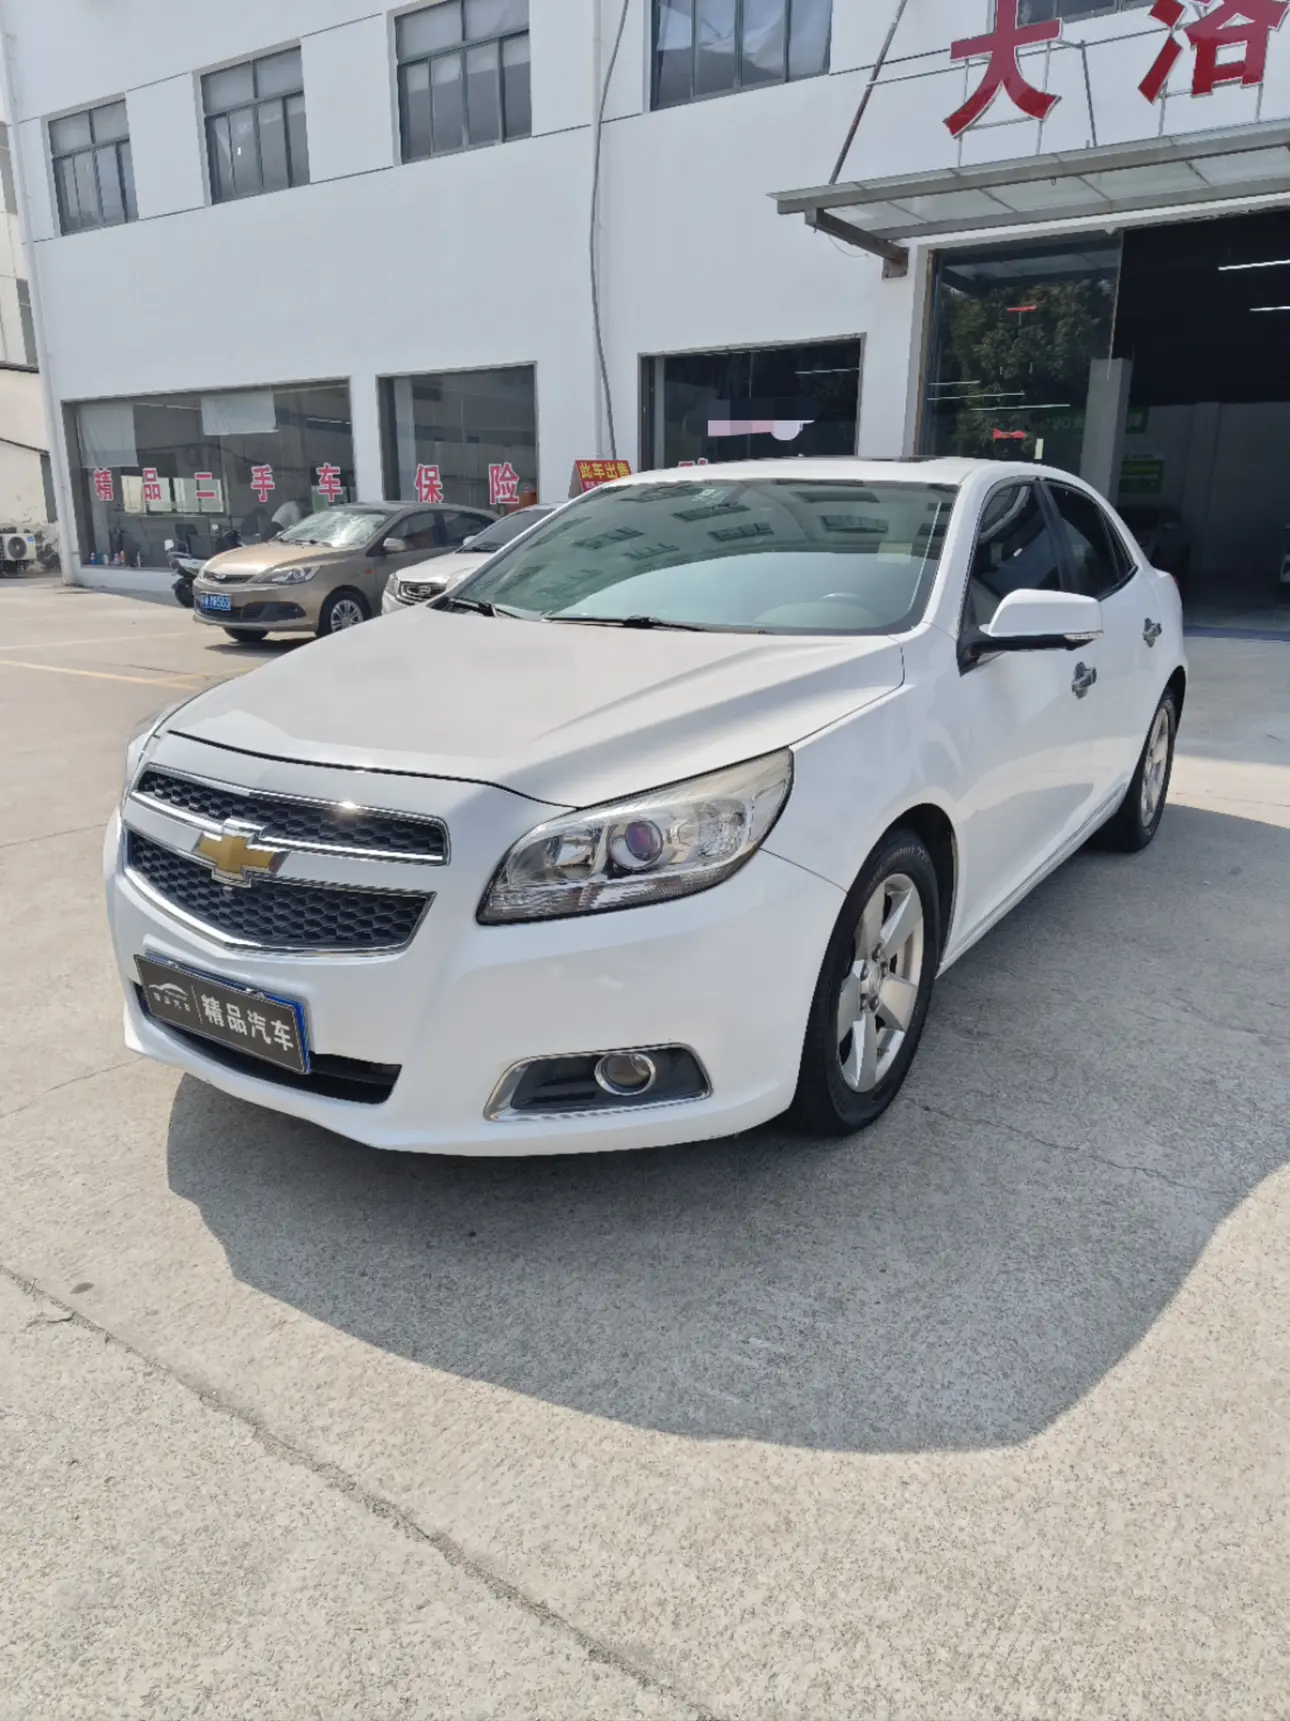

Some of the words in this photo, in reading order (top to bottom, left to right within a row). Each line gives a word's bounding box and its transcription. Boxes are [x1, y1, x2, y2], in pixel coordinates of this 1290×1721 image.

[93, 462, 342, 503] 精品二手车
[414, 462, 520, 505] 保险
[201, 994, 294, 1051] 精品汽车
